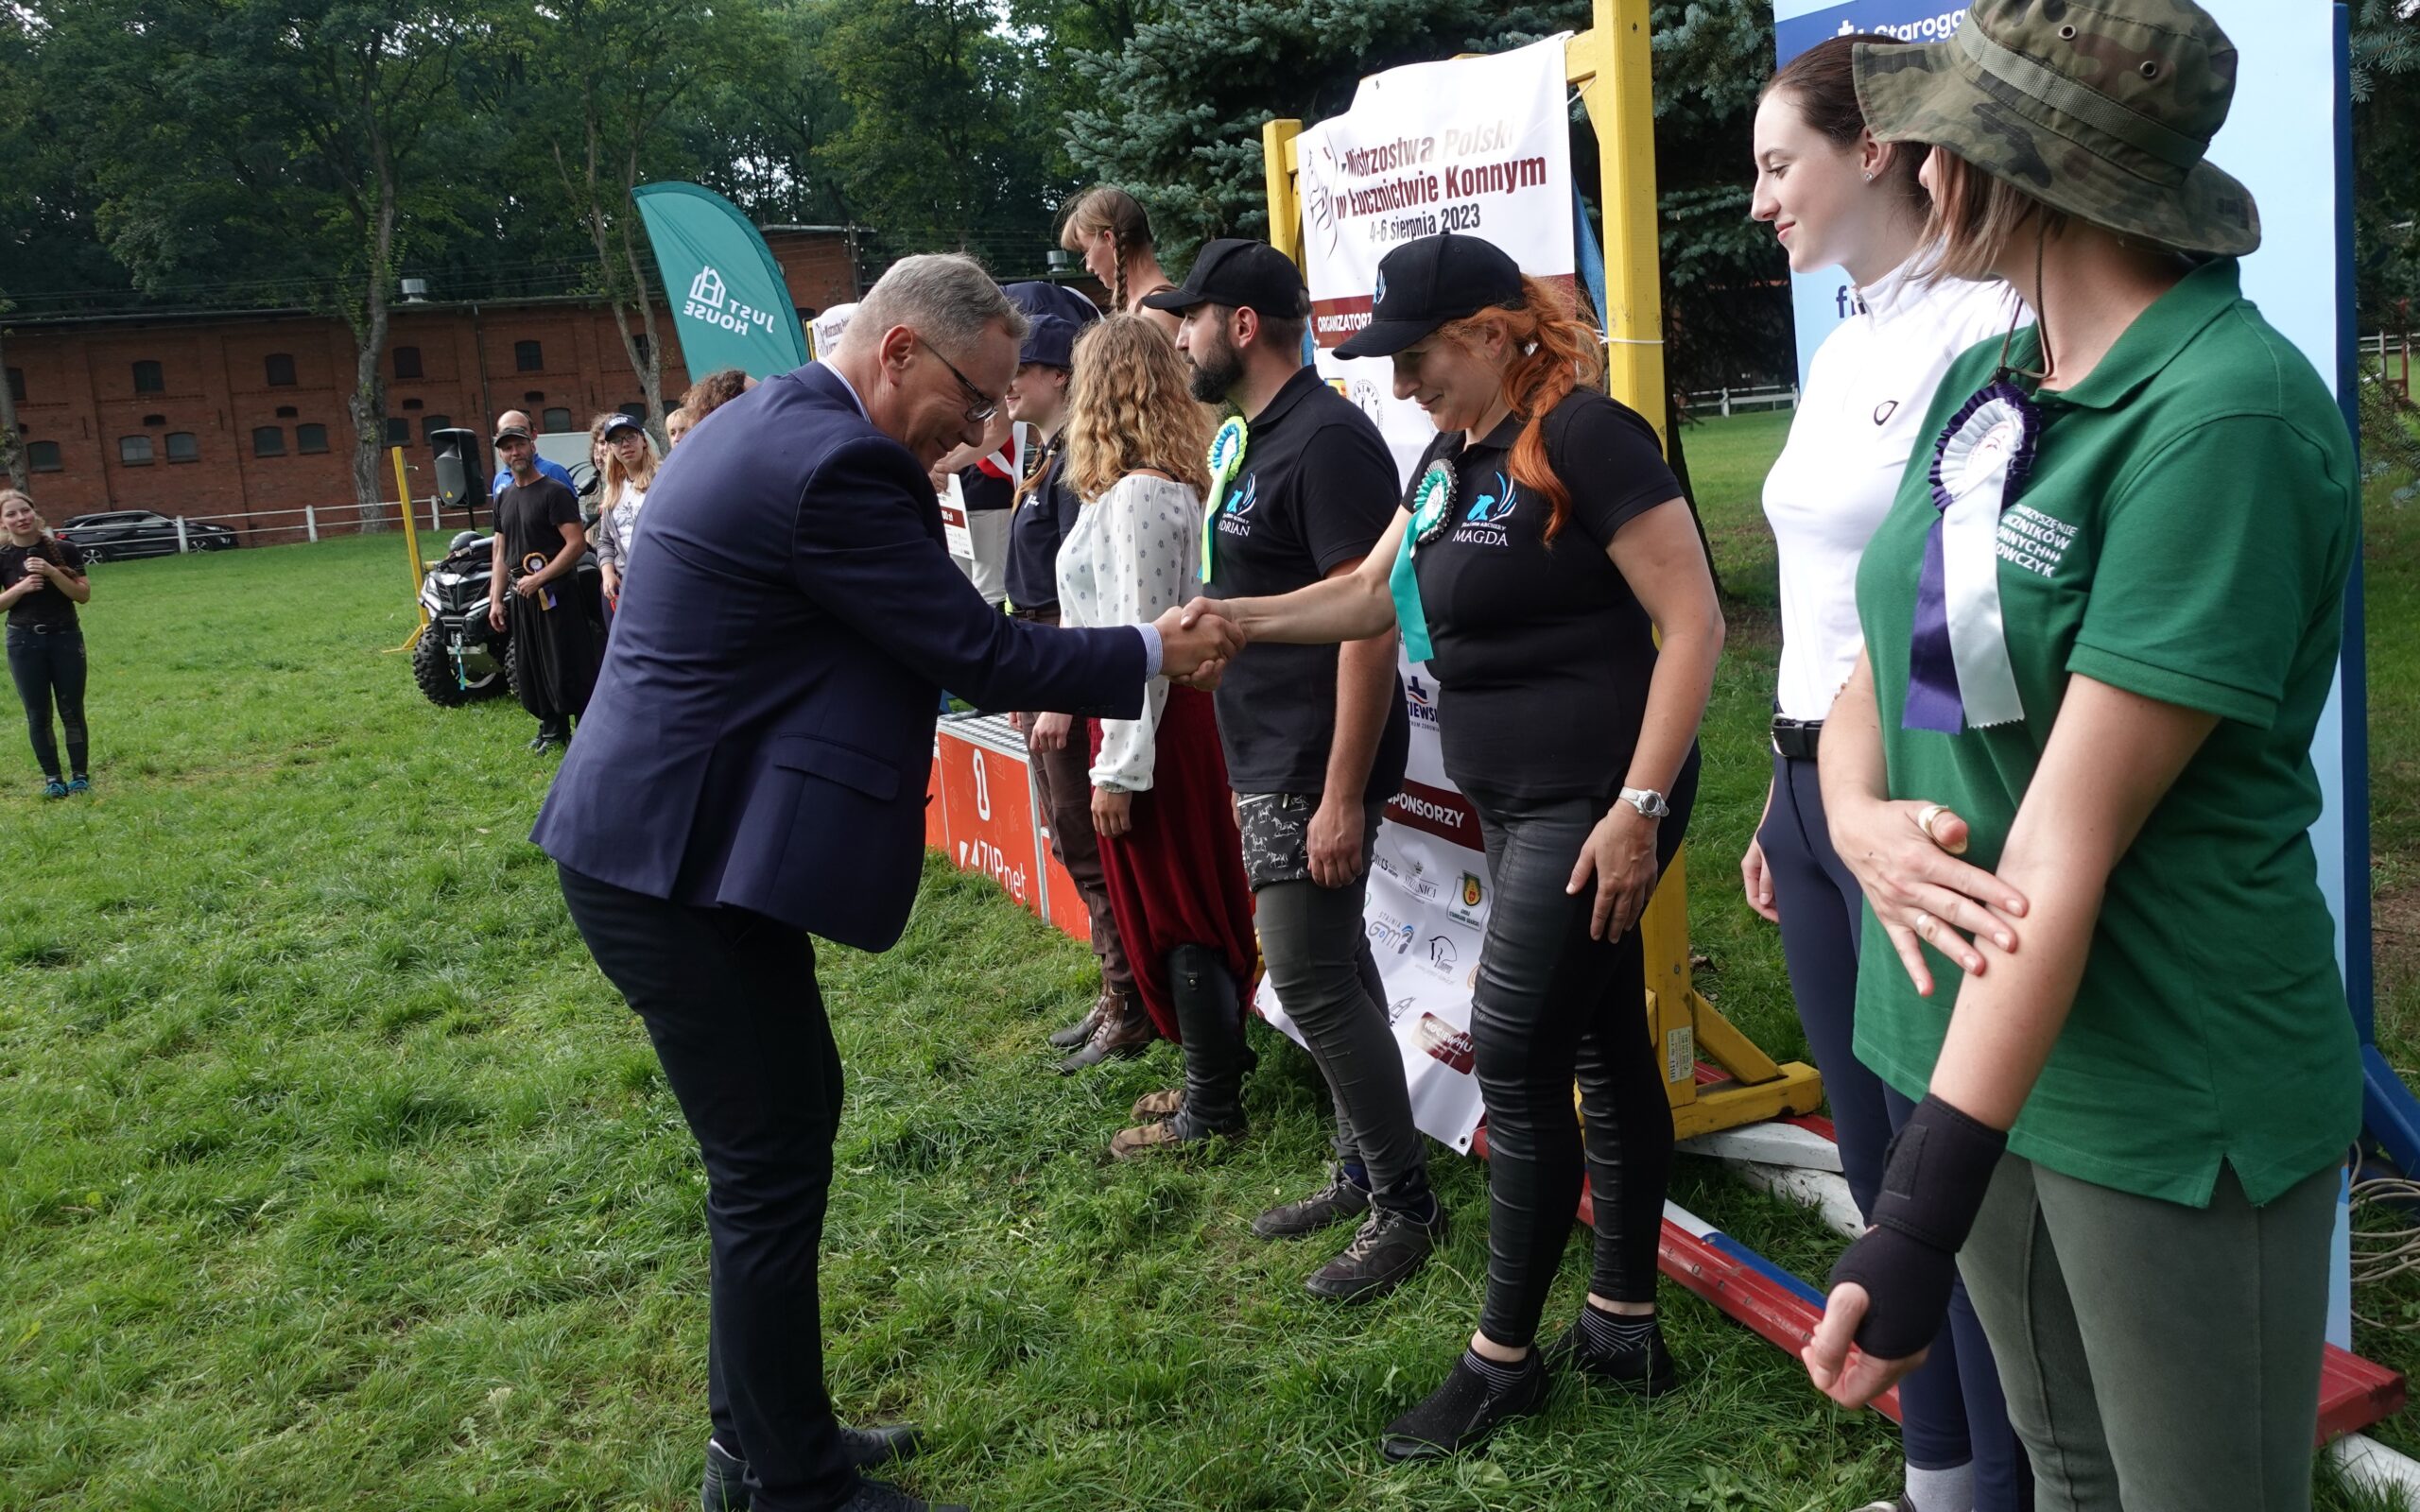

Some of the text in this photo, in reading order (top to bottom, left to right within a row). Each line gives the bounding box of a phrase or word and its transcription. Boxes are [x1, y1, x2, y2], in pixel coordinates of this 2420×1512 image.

[1345, 136, 1435, 178] Mistrzostwa
[1335, 156, 1547, 220] w Łucznictwie Konnym
[1370, 203, 1481, 243] 4-6 sierpnia 2023
[1452, 529, 1509, 546] MAGDA
[1378, 911, 1402, 928] STAJNIA
